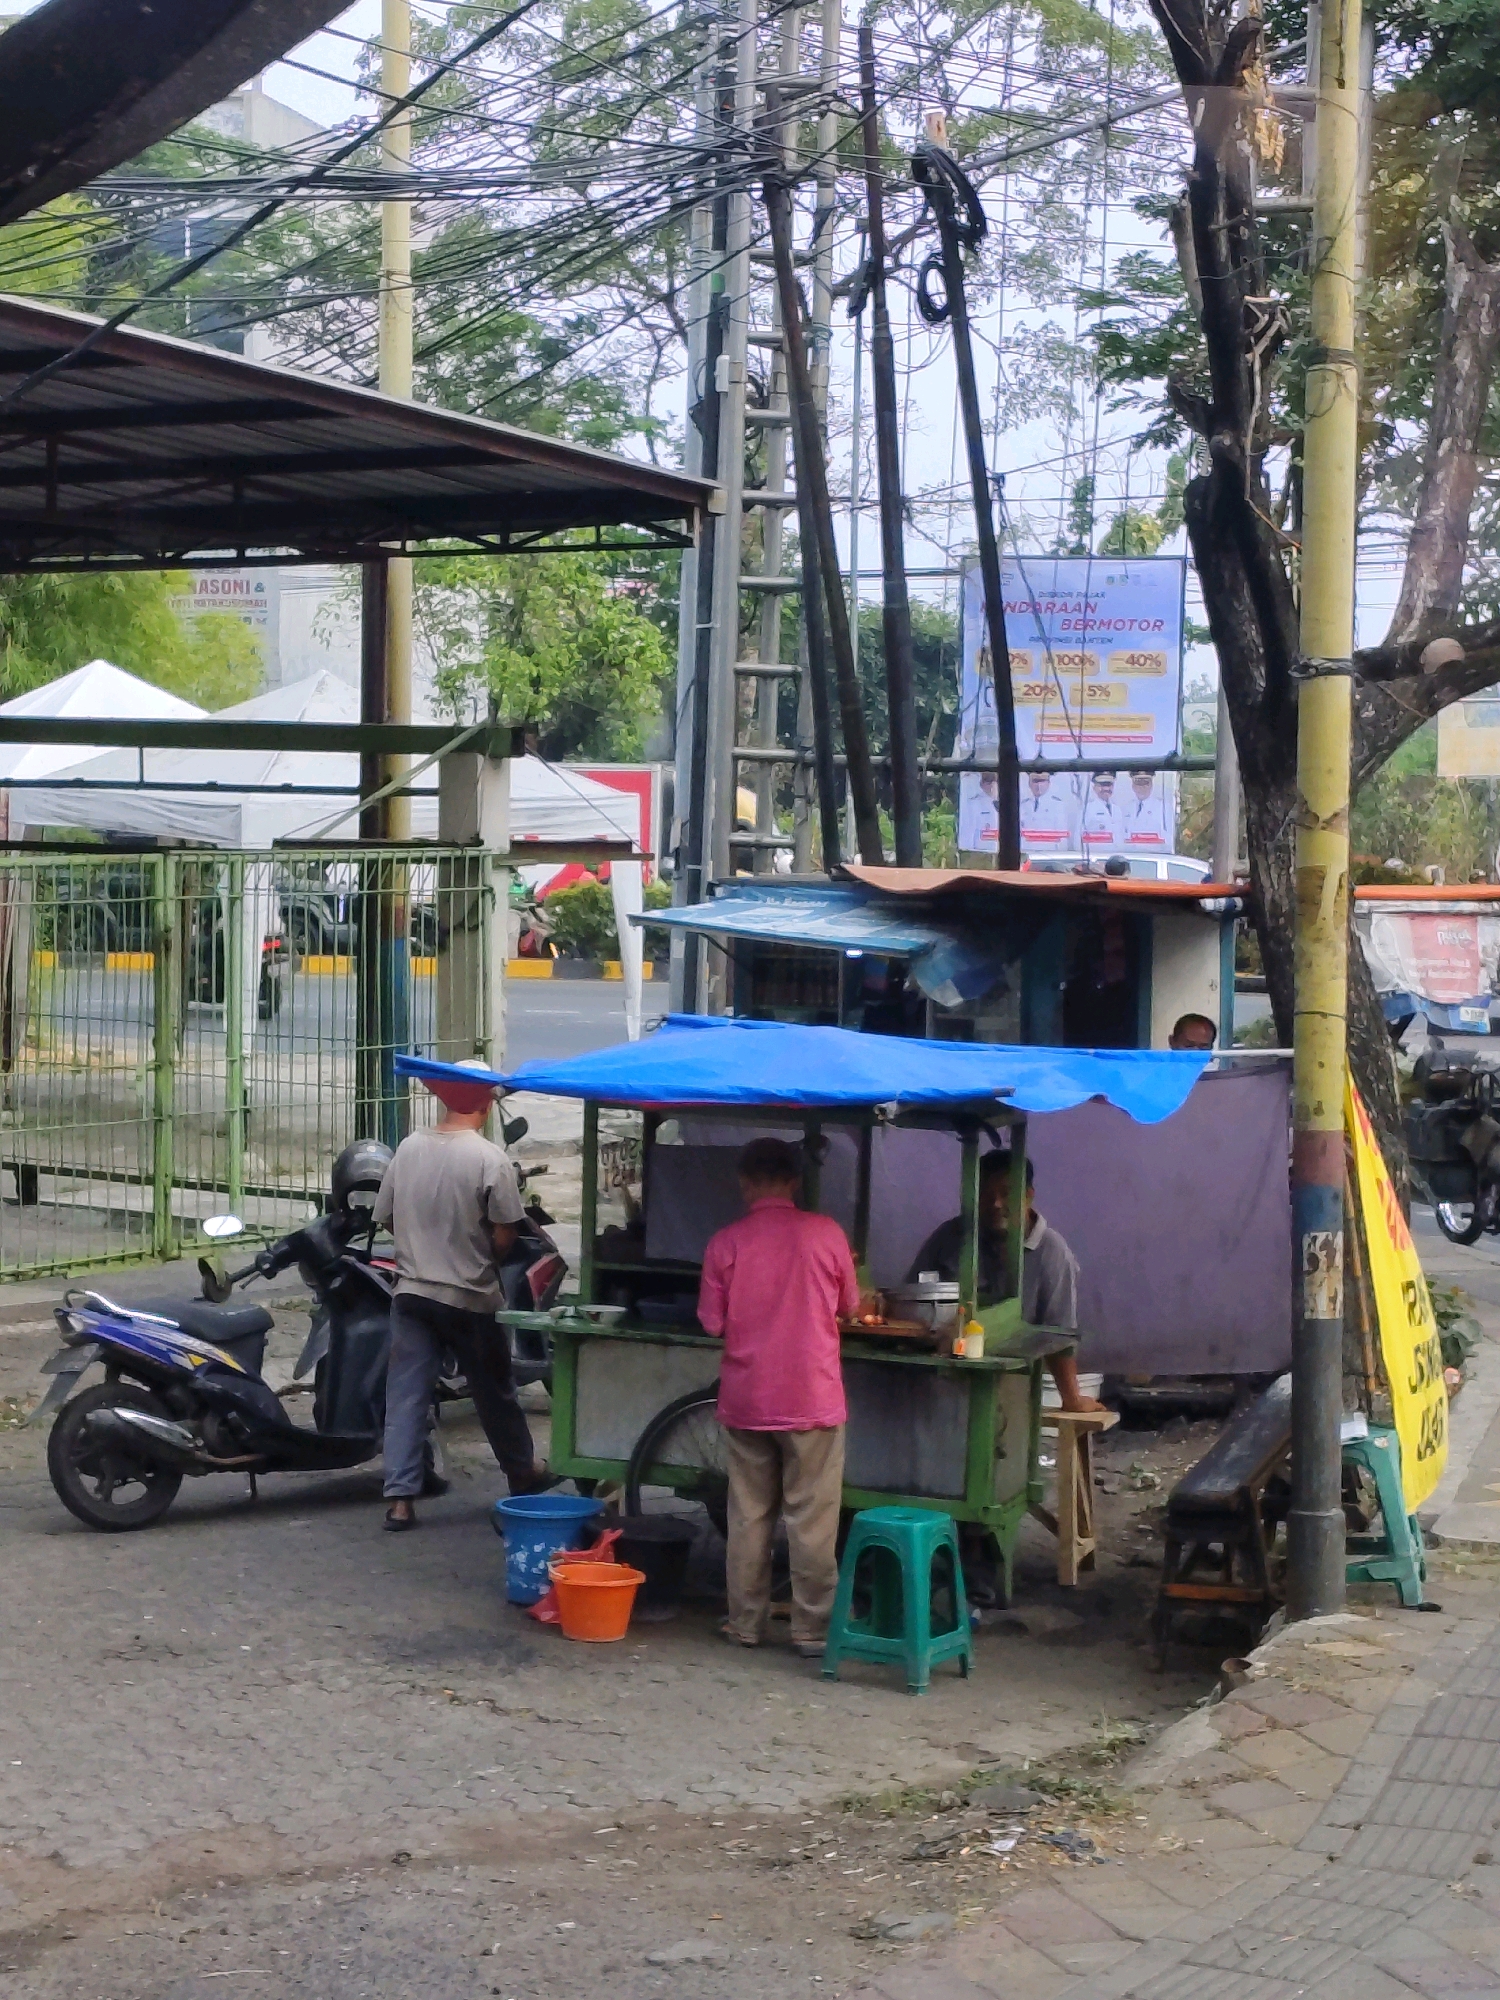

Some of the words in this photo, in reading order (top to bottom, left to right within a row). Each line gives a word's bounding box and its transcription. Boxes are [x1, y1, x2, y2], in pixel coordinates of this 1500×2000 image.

[979, 601, 1098, 615] NDARAAN
[1061, 617, 1165, 632] BERMOTOR
[1055, 653, 1095, 667] 100%
[1125, 653, 1162, 667] 40%
[1023, 683, 1057, 697] 20%
[1087, 685, 1111, 698] 5%
